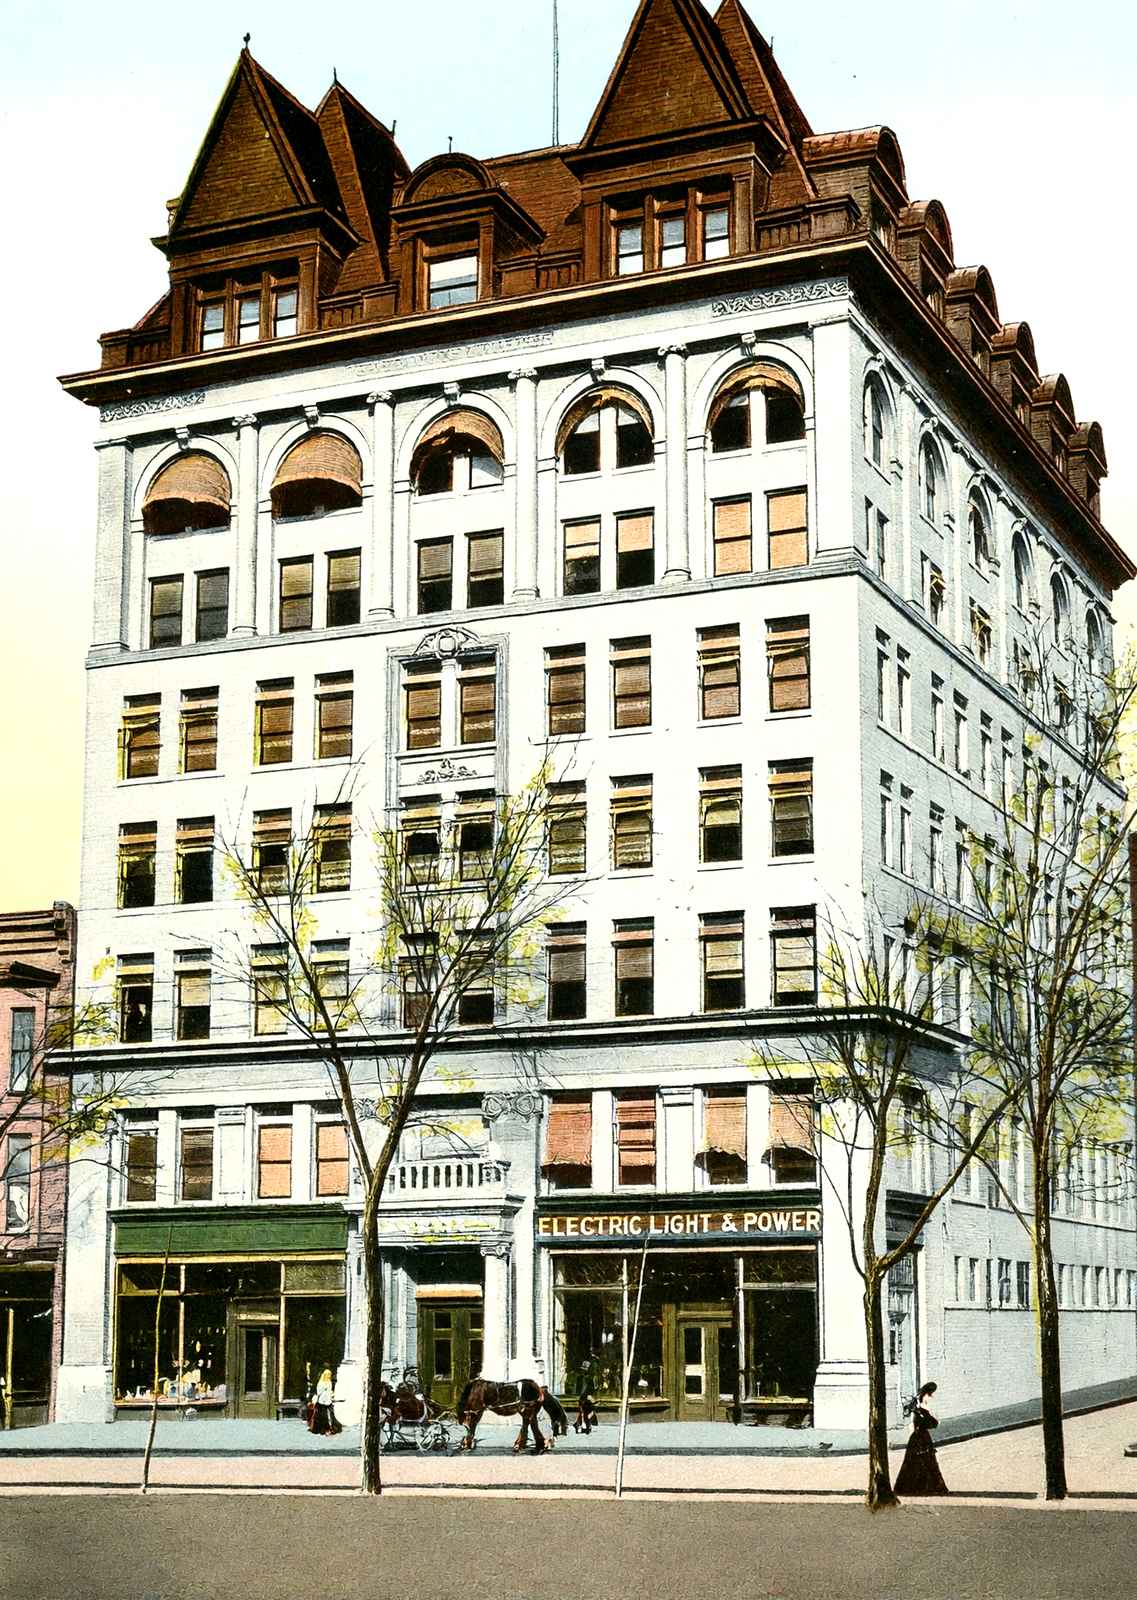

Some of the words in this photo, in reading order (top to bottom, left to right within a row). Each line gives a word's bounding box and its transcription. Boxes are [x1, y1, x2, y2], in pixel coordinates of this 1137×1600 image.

[538, 1215, 642, 1237] ELECTRIC
[648, 1213, 712, 1235] LIGHT
[720, 1212, 739, 1233] &
[743, 1210, 821, 1233] POWER
